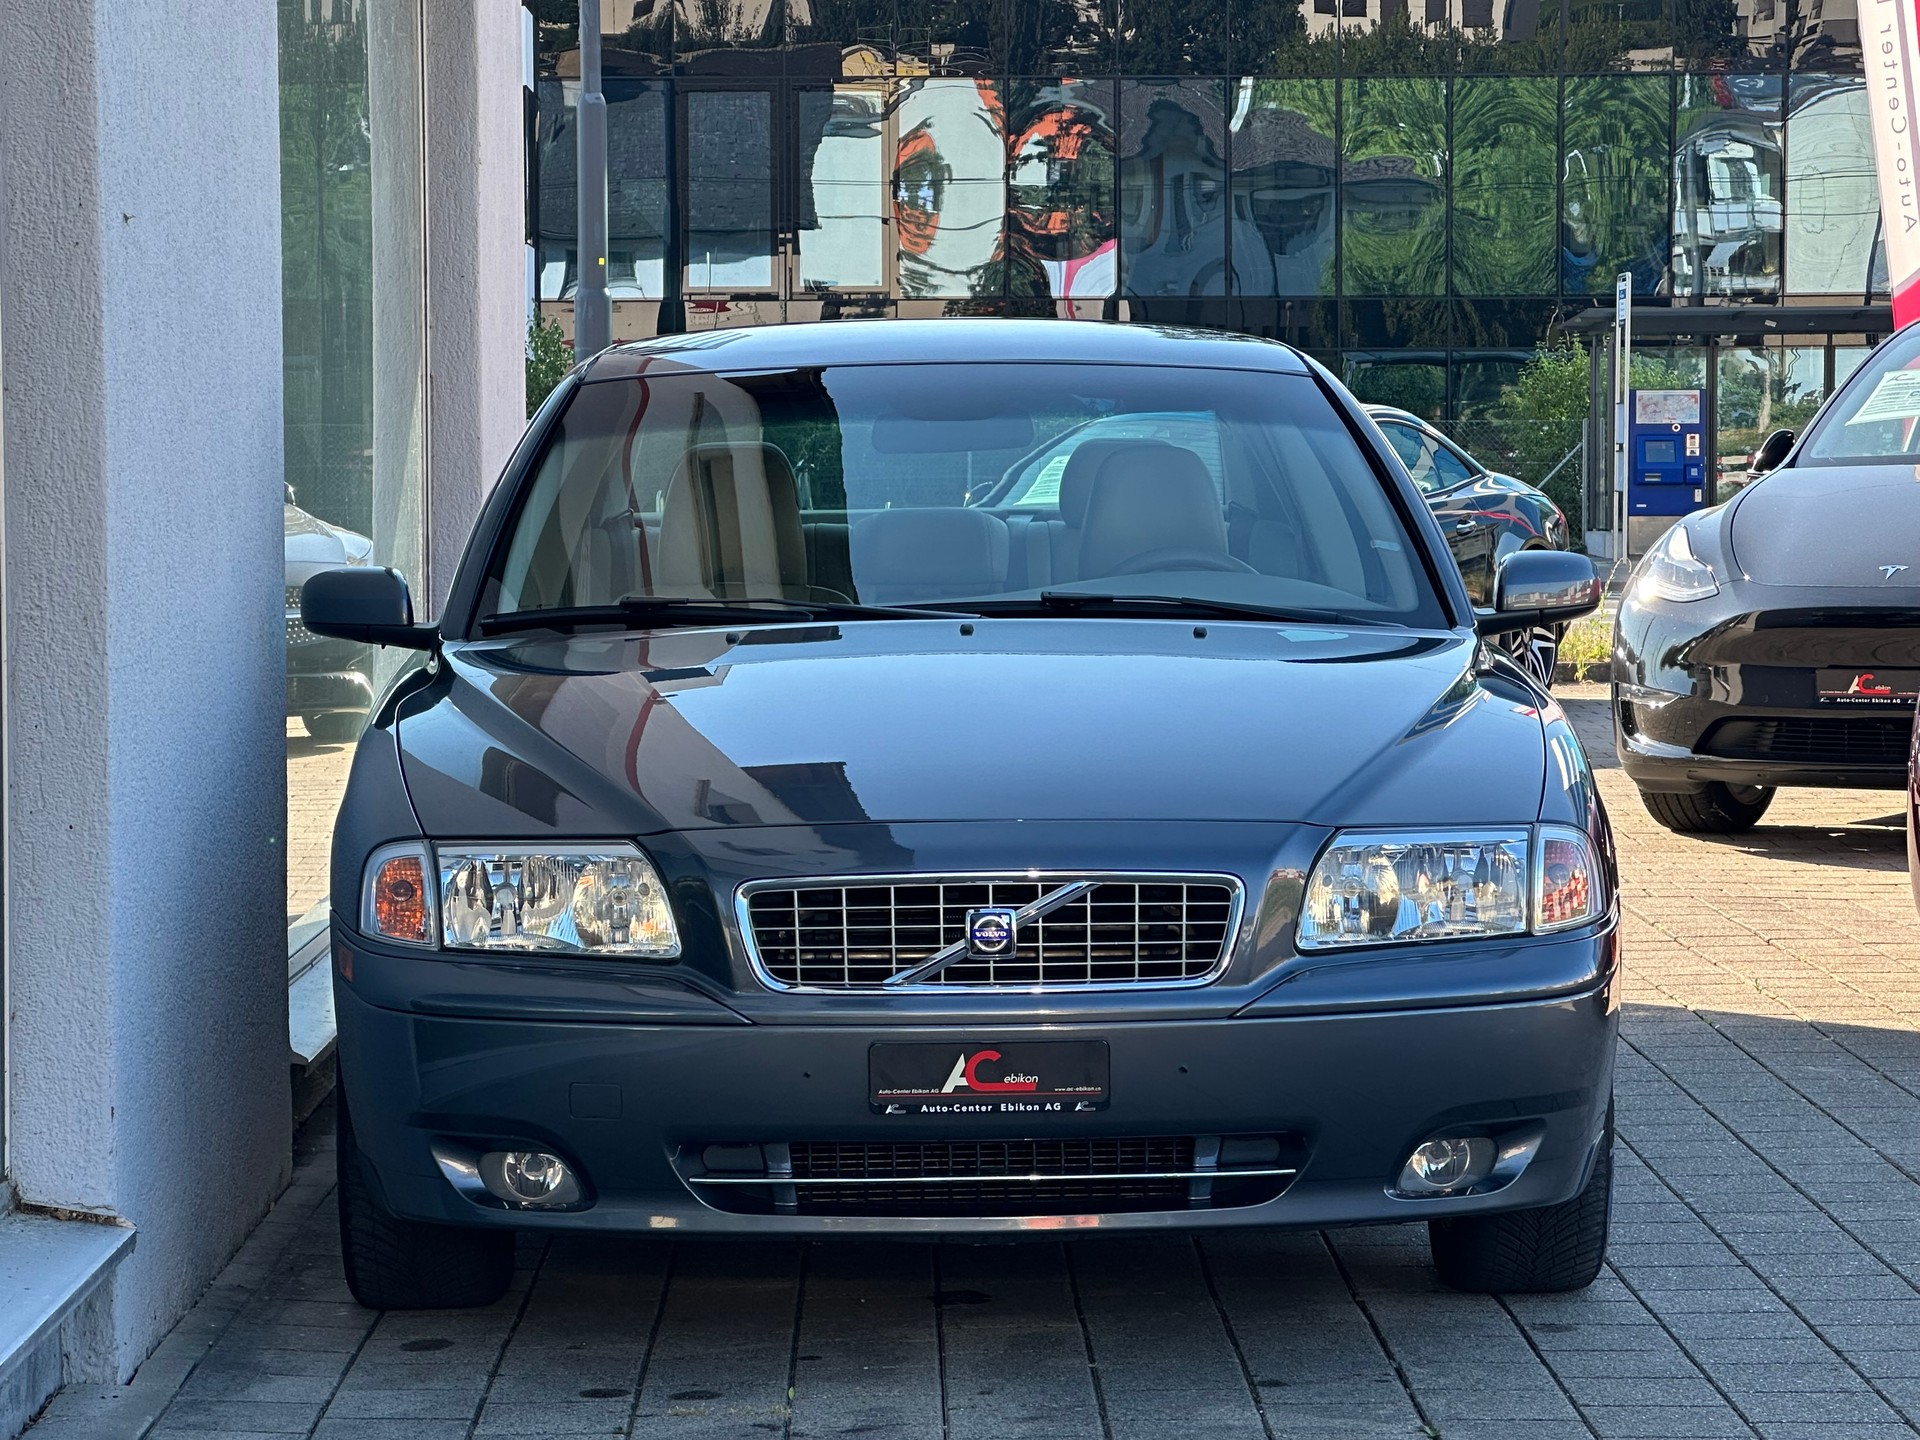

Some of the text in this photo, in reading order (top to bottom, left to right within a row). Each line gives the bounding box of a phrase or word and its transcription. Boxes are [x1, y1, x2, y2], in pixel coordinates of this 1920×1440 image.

[1847, 673, 1890, 694] AC
[941, 1050, 1037, 1093] AC
[1004, 1073, 1039, 1083] ebikon
[920, 1102, 1061, 1113] Auto-Center Ebikon AG
